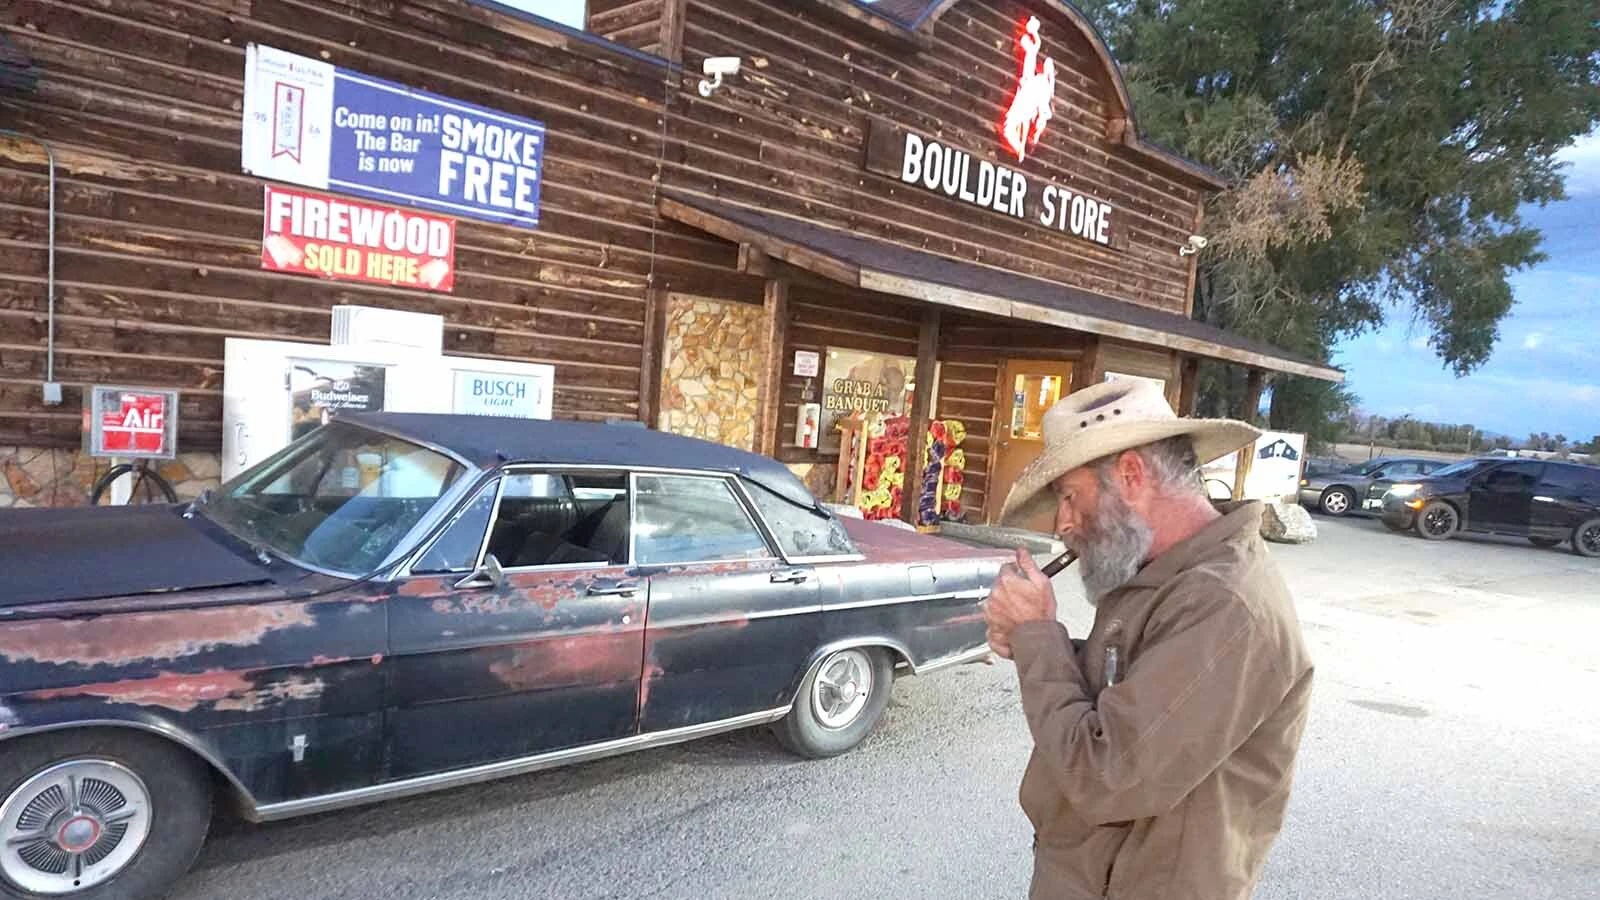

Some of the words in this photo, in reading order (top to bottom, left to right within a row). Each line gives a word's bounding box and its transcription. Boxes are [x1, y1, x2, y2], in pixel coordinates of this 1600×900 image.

[334, 106, 387, 130] Come
[390, 113, 413, 131] on
[415, 112, 440, 134] in!
[354, 129, 387, 151] The
[389, 131, 421, 153] Bar
[441, 113, 540, 168] SMOKE
[358, 152, 375, 172] is
[378, 156, 414, 173] now
[438, 151, 538, 213] FREE
[901, 132, 1028, 219] BOULDER
[1039, 184, 1112, 245] STORE
[269, 191, 450, 258] FIREWOOD
[303, 242, 361, 276] SOLD
[366, 251, 419, 284] HERE
[311, 389, 369, 403] Budweiser
[473, 379, 526, 399] BUSCH
[834, 379, 871, 397] GRAB
[874, 383, 883, 398] A
[484, 397, 515, 407] LIGHT
[826, 395, 889, 412] BANQUET
[122, 407, 164, 429] Air
